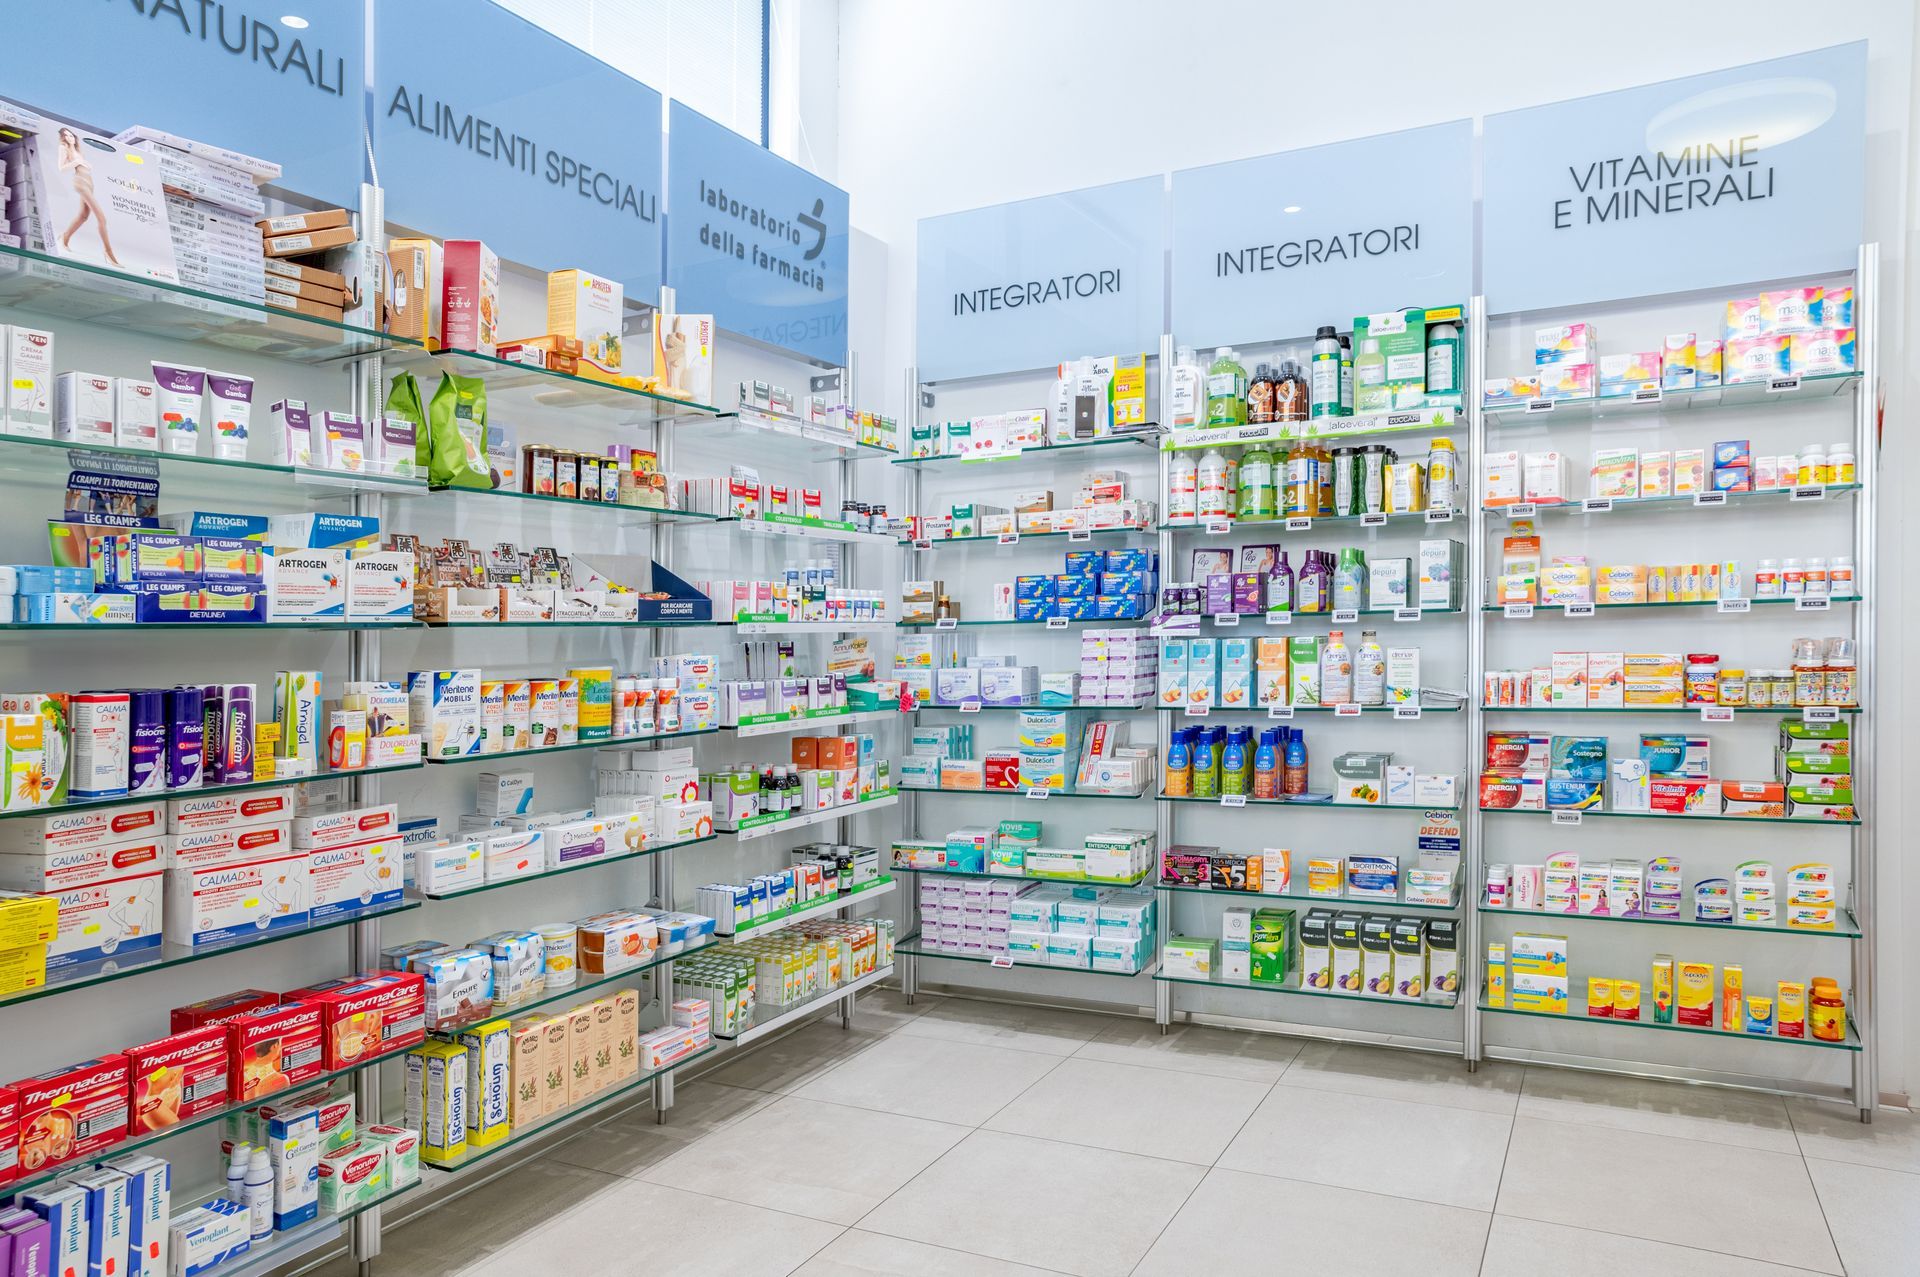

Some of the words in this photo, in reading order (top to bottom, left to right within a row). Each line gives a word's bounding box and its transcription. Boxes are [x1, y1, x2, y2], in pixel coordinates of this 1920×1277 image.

[120, 0, 345, 97] ATURALI
[388, 85, 536, 176] ALIMENTI
[545, 150, 657, 224] SPECIALI
[1569, 134, 1759, 193] VITAMINE
[111, 194, 157, 212] WONDERFUL
[1554, 199, 1572, 229] E
[1586, 167, 1774, 225] MINERALI
[112, 200, 129, 212] HIPS
[130, 206, 157, 218] SHAPER
[700, 179, 802, 247] laboratorio
[1217, 223, 1420, 278] INTEGRATORI
[700, 222, 745, 260] della
[753, 245, 825, 292] farmacia
[592, 278, 612, 294] APROTEN
[954, 268, 1121, 316] INTEGRATORI
[700, 319, 709, 346] APROTEN
[29, 335, 47, 346] VEN
[92, 379, 108, 389] VEN
[170, 382, 196, 392] Gambe
[136, 386, 152, 396] VEN
[225, 389, 247, 399] Gambe
[1211, 403, 1225, 416] x2
[1388, 414, 1420, 425] ZUCCARI
[1240, 428, 1268, 438] ZUCCARI
[76, 475, 102, 486] CRAMPI
[111, 478, 158, 491] TORMENTANO?
[84, 513, 103, 524] LEG
[104, 515, 142, 527] CRAMPS
[199, 515, 248, 527] ARTROGEN
[319, 517, 363, 528] ARTROGEN
[199, 524, 230, 532] ADVANCE
[142, 536, 154, 545] LEG
[155, 537, 181, 545] CRAMPS
[207, 539, 218, 547] LEG
[219, 540, 243, 548] CRAMPS
[1421, 549, 1446, 558] depura
[278, 558, 327, 569] ARTROGEN
[355, 562, 398, 571] ARTROGEN
[1372, 567, 1397, 577] depura
[1609, 571, 1633, 579] Cebion
[146, 583, 158, 591] LEG
[159, 584, 186, 592] CRAMPS
[224, 585, 247, 593] CRAMPS
[1609, 590, 1633, 598] Cebion
[189, 611, 226, 619] DIETALINEA
[440, 684, 474, 695] Meritene
[369, 696, 407, 705] DOLORELAX
[443, 695, 472, 703] MOBILIS
[96, 705, 127, 714] CALMA
[297, 699, 311, 745] Arnigel
[752, 715, 777, 724] DIGESTIONE
[1027, 716, 1056, 724] DulceSoft
[234, 711, 247, 763] fisiocrem
[380, 739, 419, 750] DOLORELAX
[1572, 750, 1603, 758] Sostegno
[506, 778, 523, 787] CalDyn
[1487, 784, 1517, 792] ENERGIA
[1549, 782, 1586, 790] SUSTENIUM
[1652, 785, 1687, 793] Vitalmix
[184, 799, 237, 813] CALMADOL
[742, 818, 764, 828] CONTROLLO
[773, 813, 787, 822] PESO
[1424, 811, 1453, 819] Cebion
[52, 813, 107, 831] CALMADOL
[316, 815, 356, 829] CALMADOL
[1001, 823, 1022, 831] YOVIS
[1420, 826, 1458, 836] DEFEND
[181, 832, 236, 847] CALMADOL
[51, 850, 108, 868] CALMADOL
[313, 849, 364, 866] CALMADOL
[1353, 862, 1392, 870] BIORITMON
[200, 868, 263, 887] CALMADOL
[59, 887, 110, 906] MADOL
[519, 960, 536, 976] Ensure
[452, 982, 478, 999] Ensure
[337, 983, 420, 1015] ThermaCare
[620, 997, 635, 1008] AMARO
[597, 1005, 613, 1016] AMARO
[247, 1010, 320, 1038] ThermaCare
[574, 1015, 591, 1026] AMARO
[549, 1024, 565, 1035] AMARO
[522, 1036, 539, 1046] AMARO
[140, 1036, 226, 1069] ThermaCare
[25, 1066, 128, 1105] ThermaCare
[345, 1155, 382, 1175] Venoruton
[149, 1170, 164, 1221] Venoplant
[109, 1184, 124, 1238] Venoplant
[67, 1199, 82, 1254] Venoplant
[189, 1225, 229, 1248] Venoplant
